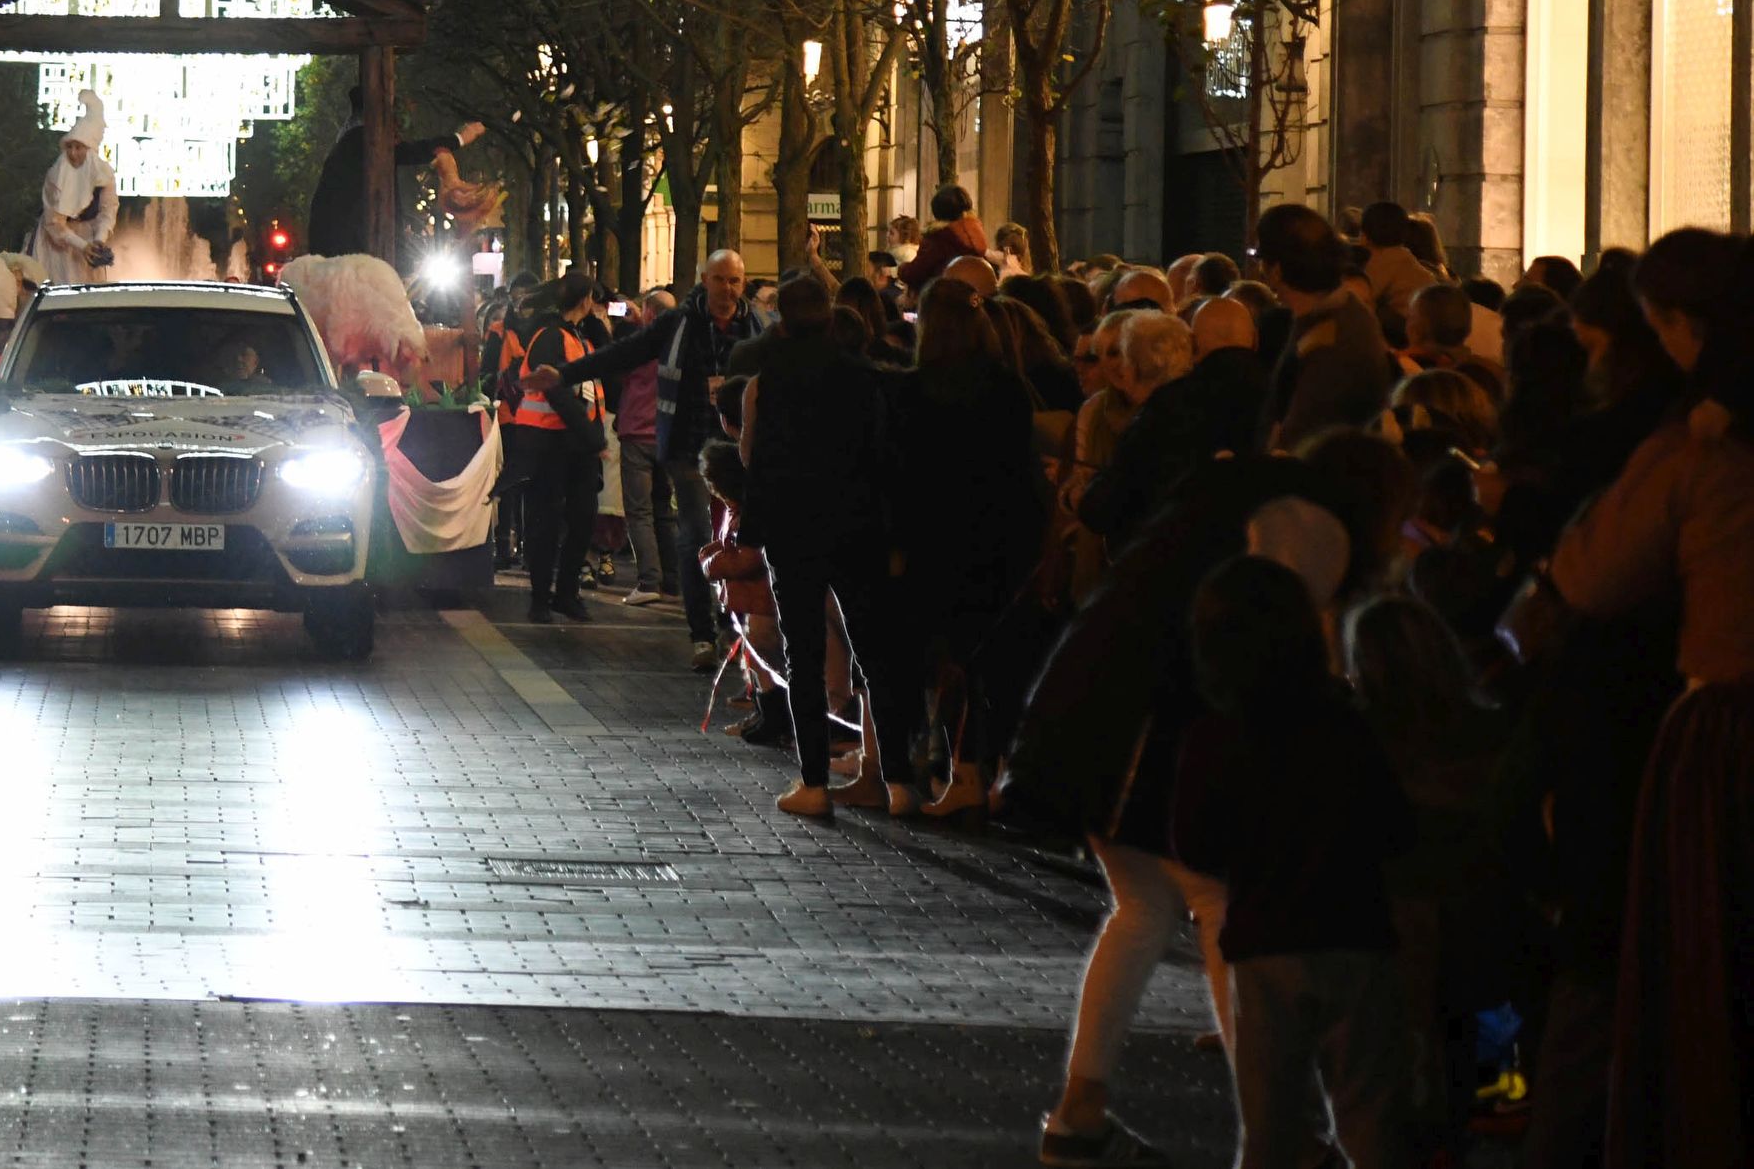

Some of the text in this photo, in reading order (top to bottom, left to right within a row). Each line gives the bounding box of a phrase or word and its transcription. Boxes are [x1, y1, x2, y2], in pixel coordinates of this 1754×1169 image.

[91, 431, 232, 442] EXPOCASION
[123, 526, 219, 547] 1707 MBP
